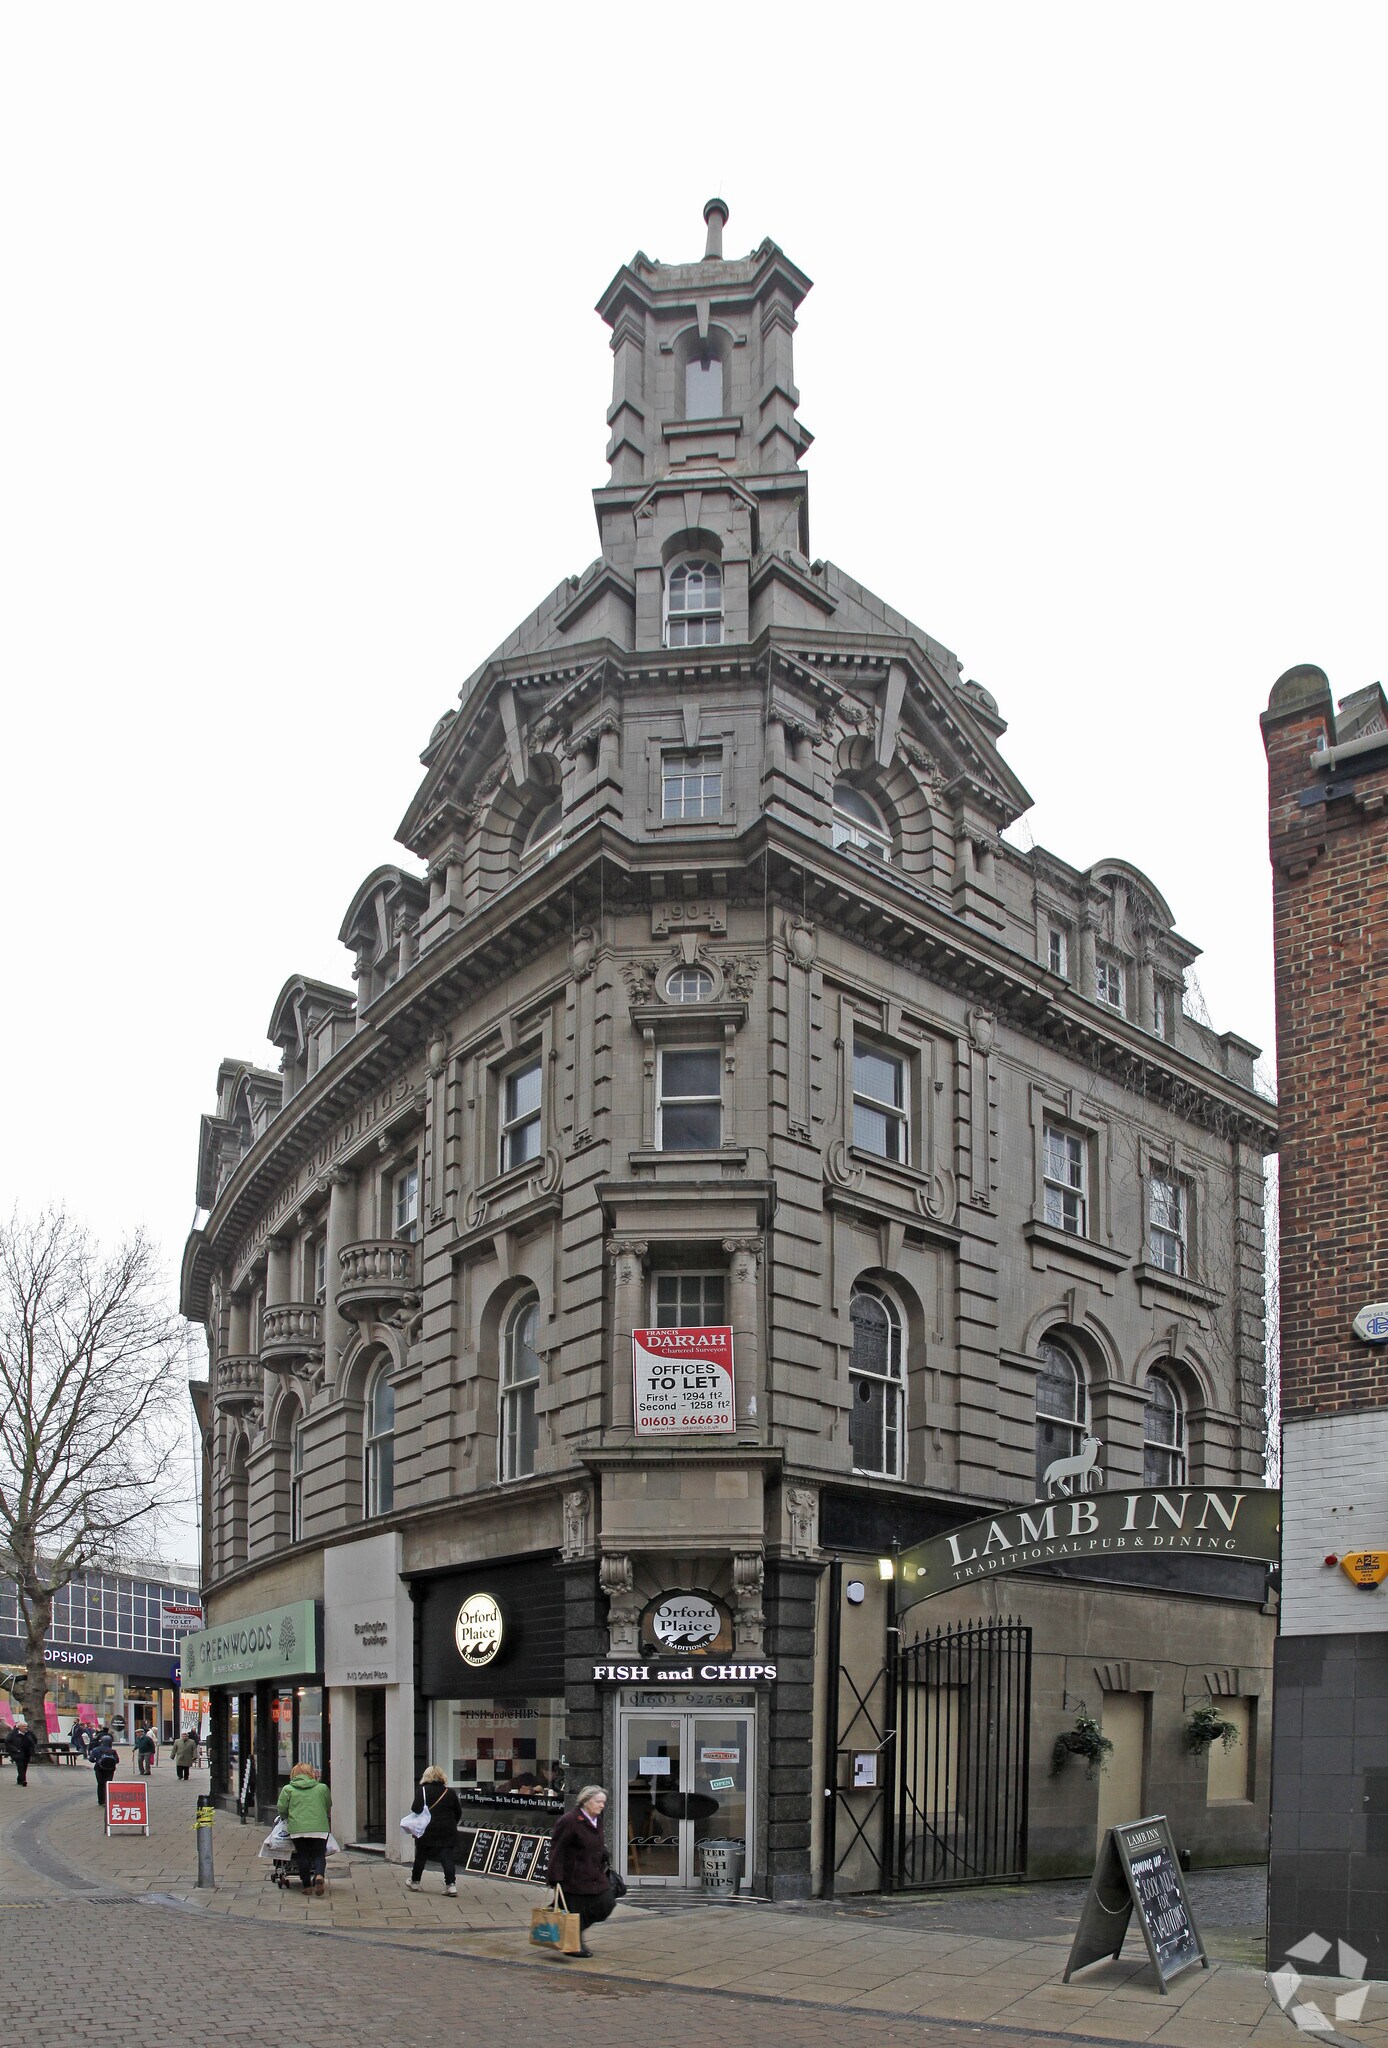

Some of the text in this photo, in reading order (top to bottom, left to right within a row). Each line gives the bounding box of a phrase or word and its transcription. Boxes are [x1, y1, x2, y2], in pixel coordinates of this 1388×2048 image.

[662, 905, 716, 921] 1904
[655, 920, 723, 931] A D
[646, 1334, 726, 1347] DARRAH
[695, 1346, 727, 1354] Surveyors
[652, 1364, 715, 1375] OFFICES
[648, 1376, 720, 1390] TO LET
[682, 1392, 705, 1400] 1294
[640, 1403, 677, 1411] Second
[690, 1401, 713, 1409] 1258
[641, 1414, 728, 1426] 01603 666630
[945, 1493, 1247, 1567] LAMB INN
[953, 1536, 1236, 1580] TRADITIONAL PUB & DINING
[1356, 1556, 1379, 1565] A2Z
[459, 1608, 497, 1625] Orford
[657, 1606, 716, 1618] Orford
[354, 1621, 388, 1635] Burlington
[660, 1620, 713, 1632] Plaice
[462, 1627, 495, 1640] Plaice
[200, 1623, 272, 1664] GREENWOODS
[363, 1636, 387, 1646] Buildings
[664, 1640, 710, 1651] TRADITIONAL
[44, 1649, 93, 1664] OPSHOP
[592, 1665, 777, 1680] FISH and CHIPS
[178, 1699, 198, 1712] ALE
[629, 1694, 745, 1704] 01603 927564
[466, 1708, 539, 1719] FISH and CHIPS
[112, 1807, 141, 1820] £75
[1127, 1828, 1160, 1846] LAMB INN
[703, 1861, 726, 1870] ISH
[703, 1878, 734, 1886] HIPS
[1142, 1876, 1161, 1900] BOOK
[1157, 1893, 1171, 1911] FOR
